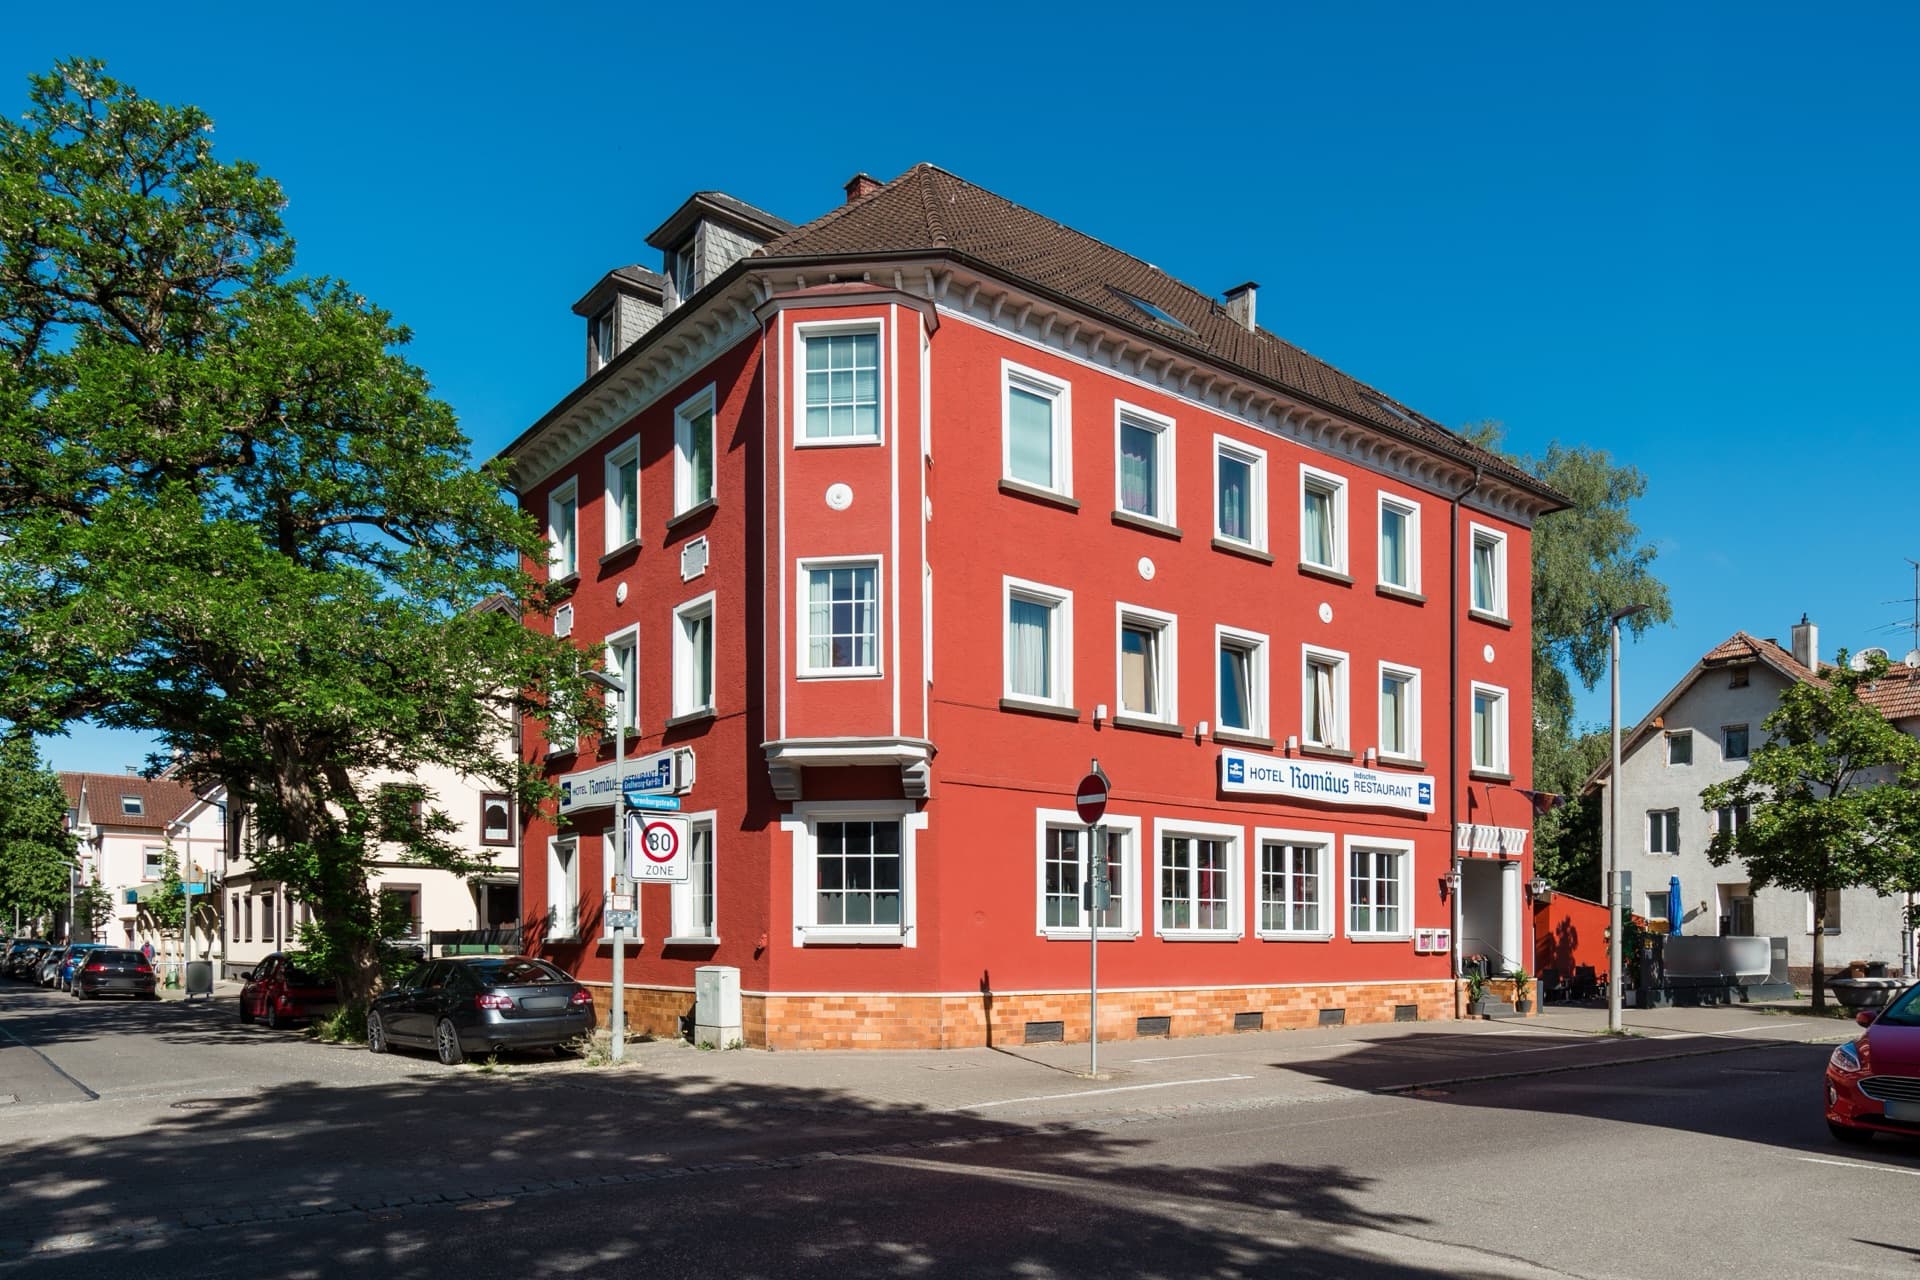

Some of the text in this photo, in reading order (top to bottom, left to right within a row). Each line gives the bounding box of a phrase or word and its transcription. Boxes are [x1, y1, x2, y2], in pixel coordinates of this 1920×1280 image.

[589, 776, 617, 796] Romäu
[1250, 766, 1349, 795] HOTEL Romäus
[1354, 780, 1413, 798] RESTAURANT
[645, 865, 675, 876] ZONE
